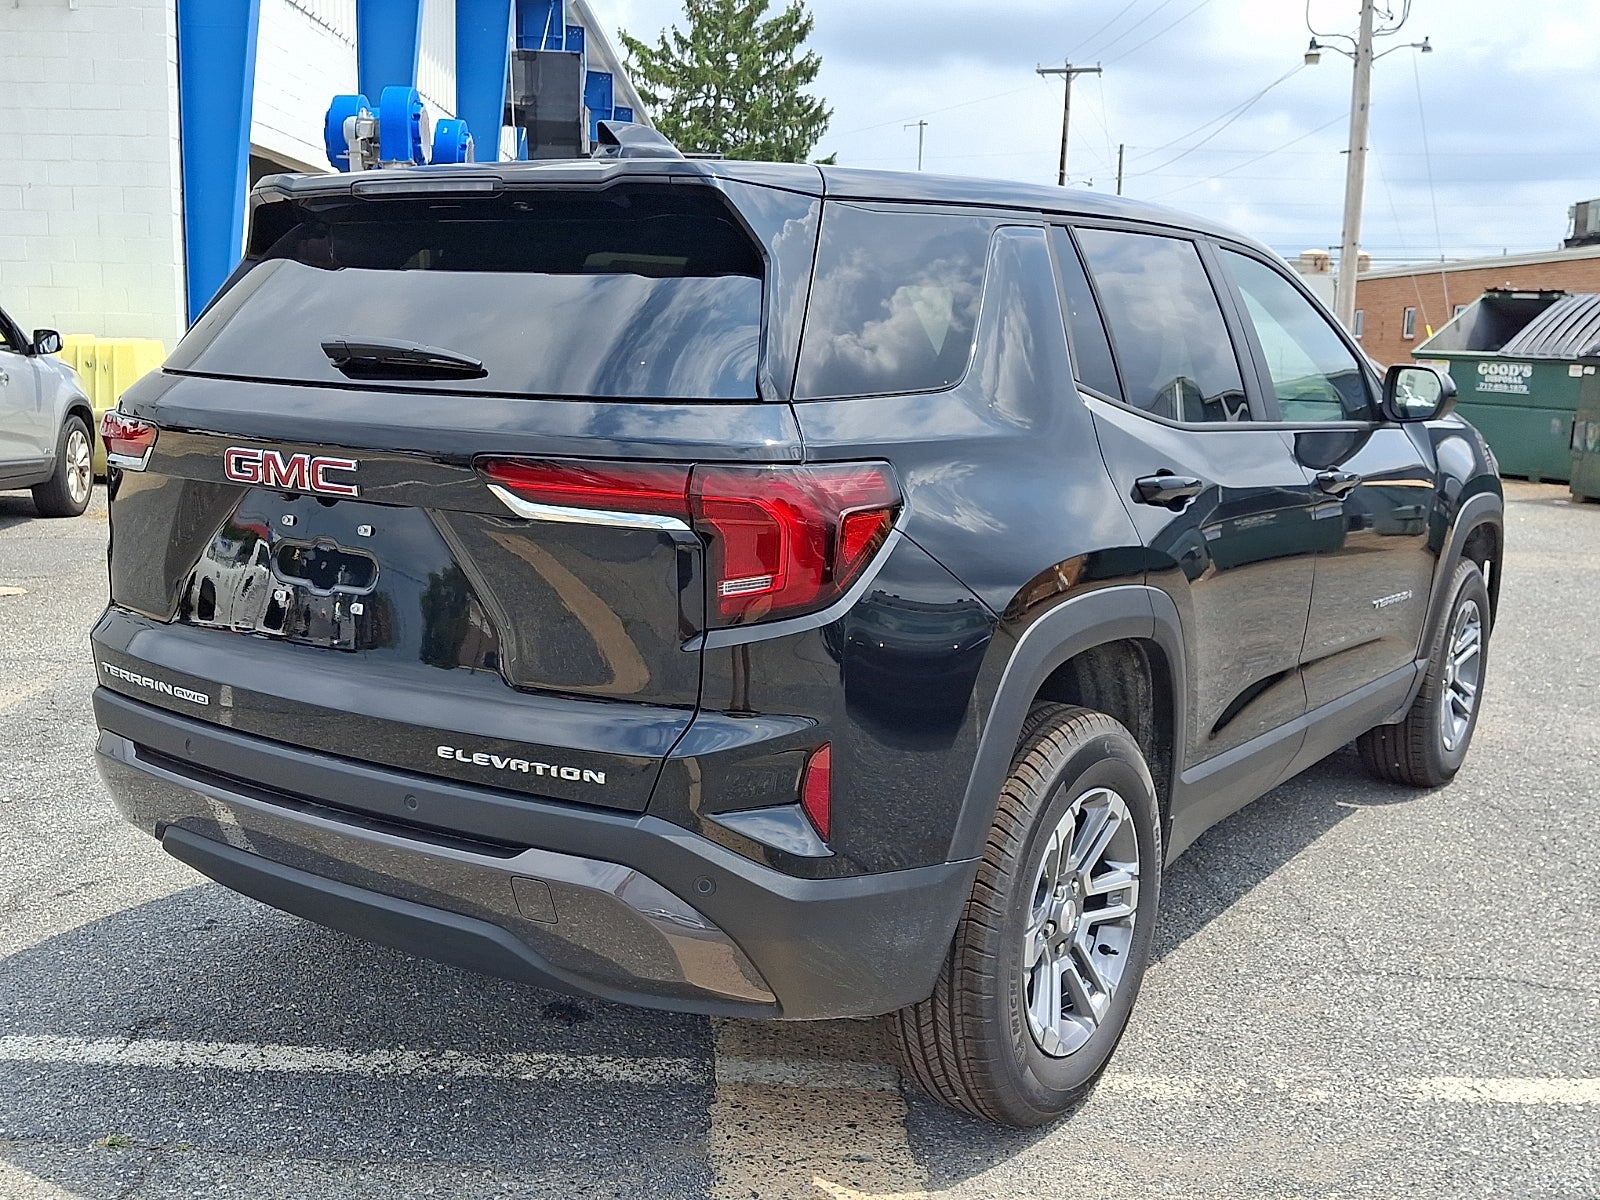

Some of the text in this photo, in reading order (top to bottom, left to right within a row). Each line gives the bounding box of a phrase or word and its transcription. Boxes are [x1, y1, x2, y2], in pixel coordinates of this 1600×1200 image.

[1477, 362, 1533, 378] GOOD'S
[224, 446, 360, 497] GMC
[101, 661, 208, 705] TERRAIN AWD
[436, 745, 606, 785] ELEVATION
